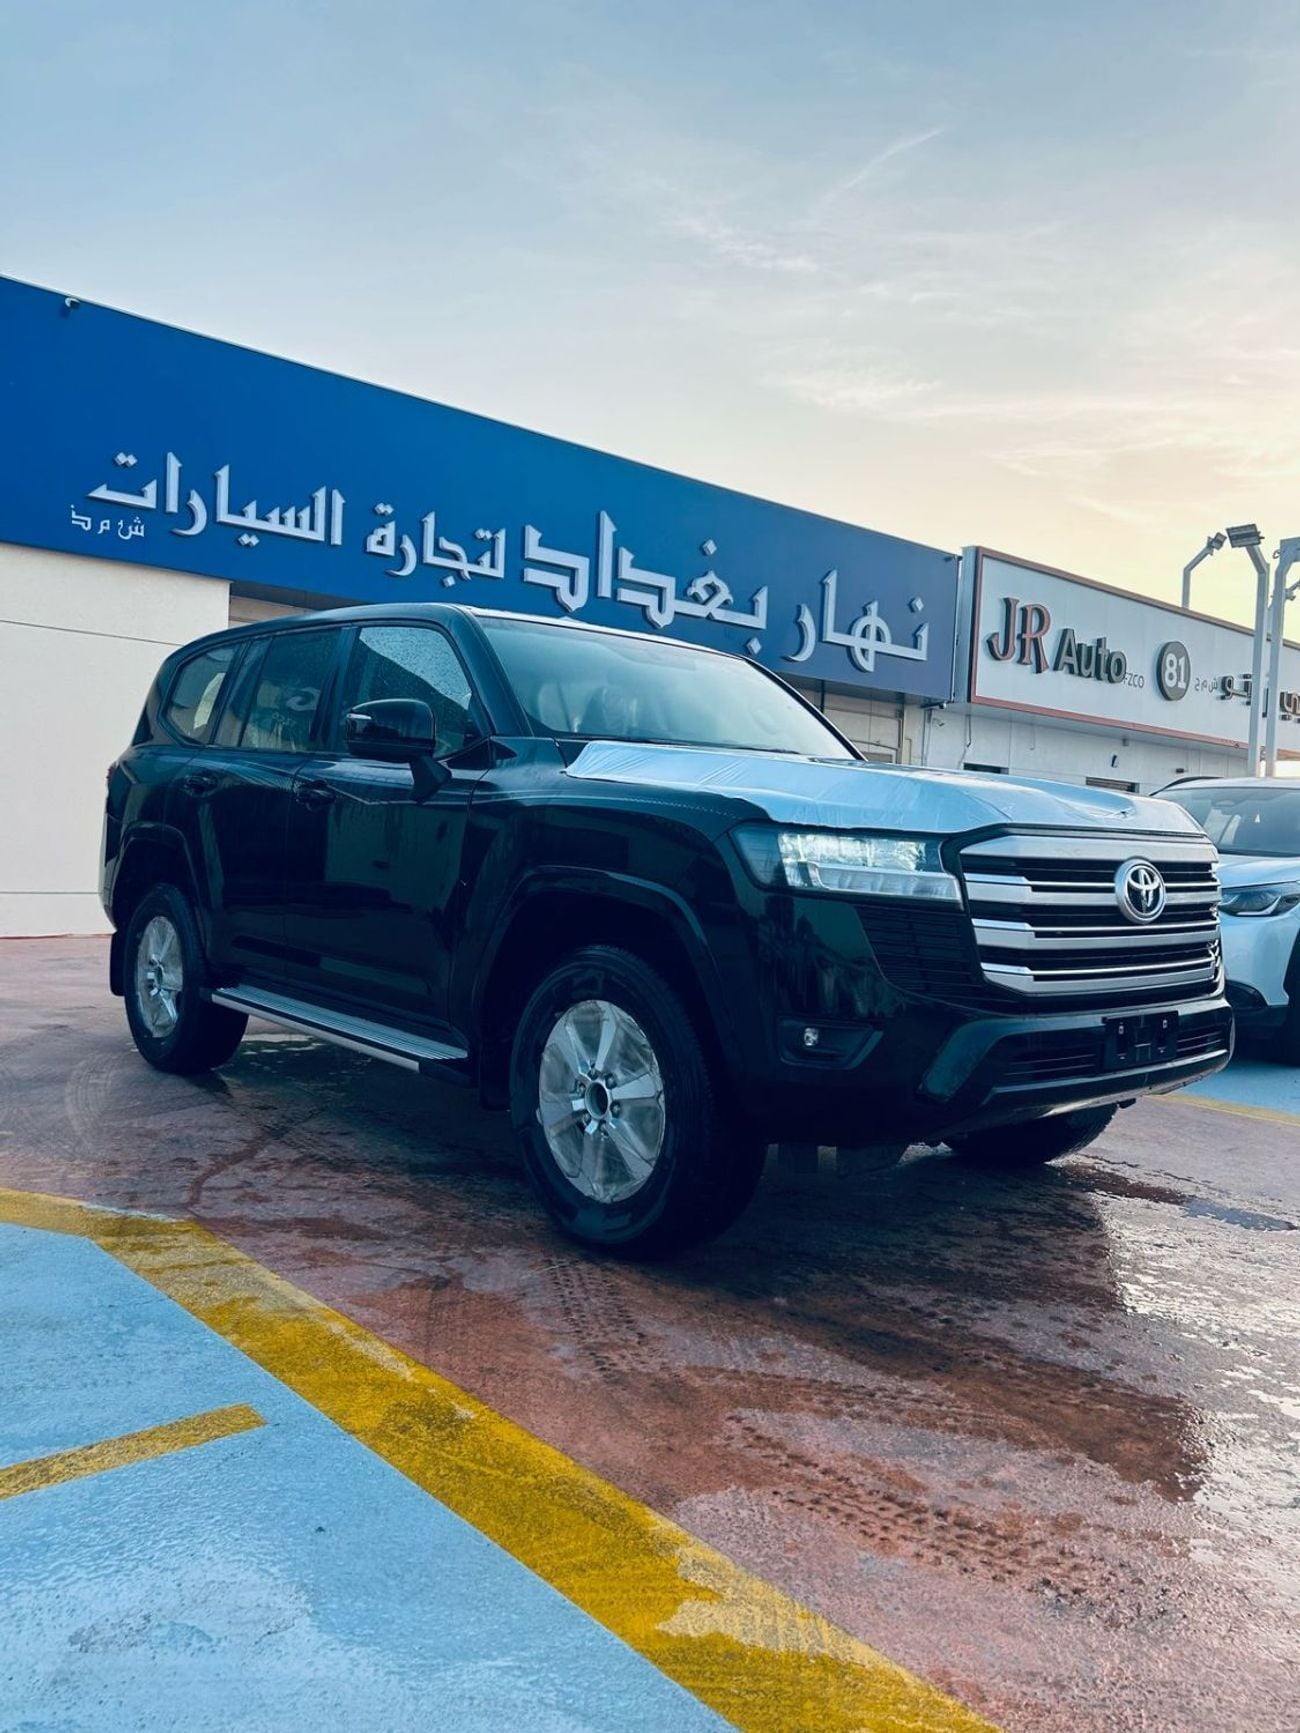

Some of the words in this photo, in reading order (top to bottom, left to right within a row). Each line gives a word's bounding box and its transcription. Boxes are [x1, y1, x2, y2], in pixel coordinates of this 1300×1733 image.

[87, 452, 344, 547] السيارات
[358, 502, 506, 588] لتجارة
[523, 510, 768, 656] بغداد
[785, 569, 930, 673] نهار
[986, 597, 1051, 674] JR
[1053, 628, 1127, 683] Auto
[1164, 652, 1186, 689] 81
